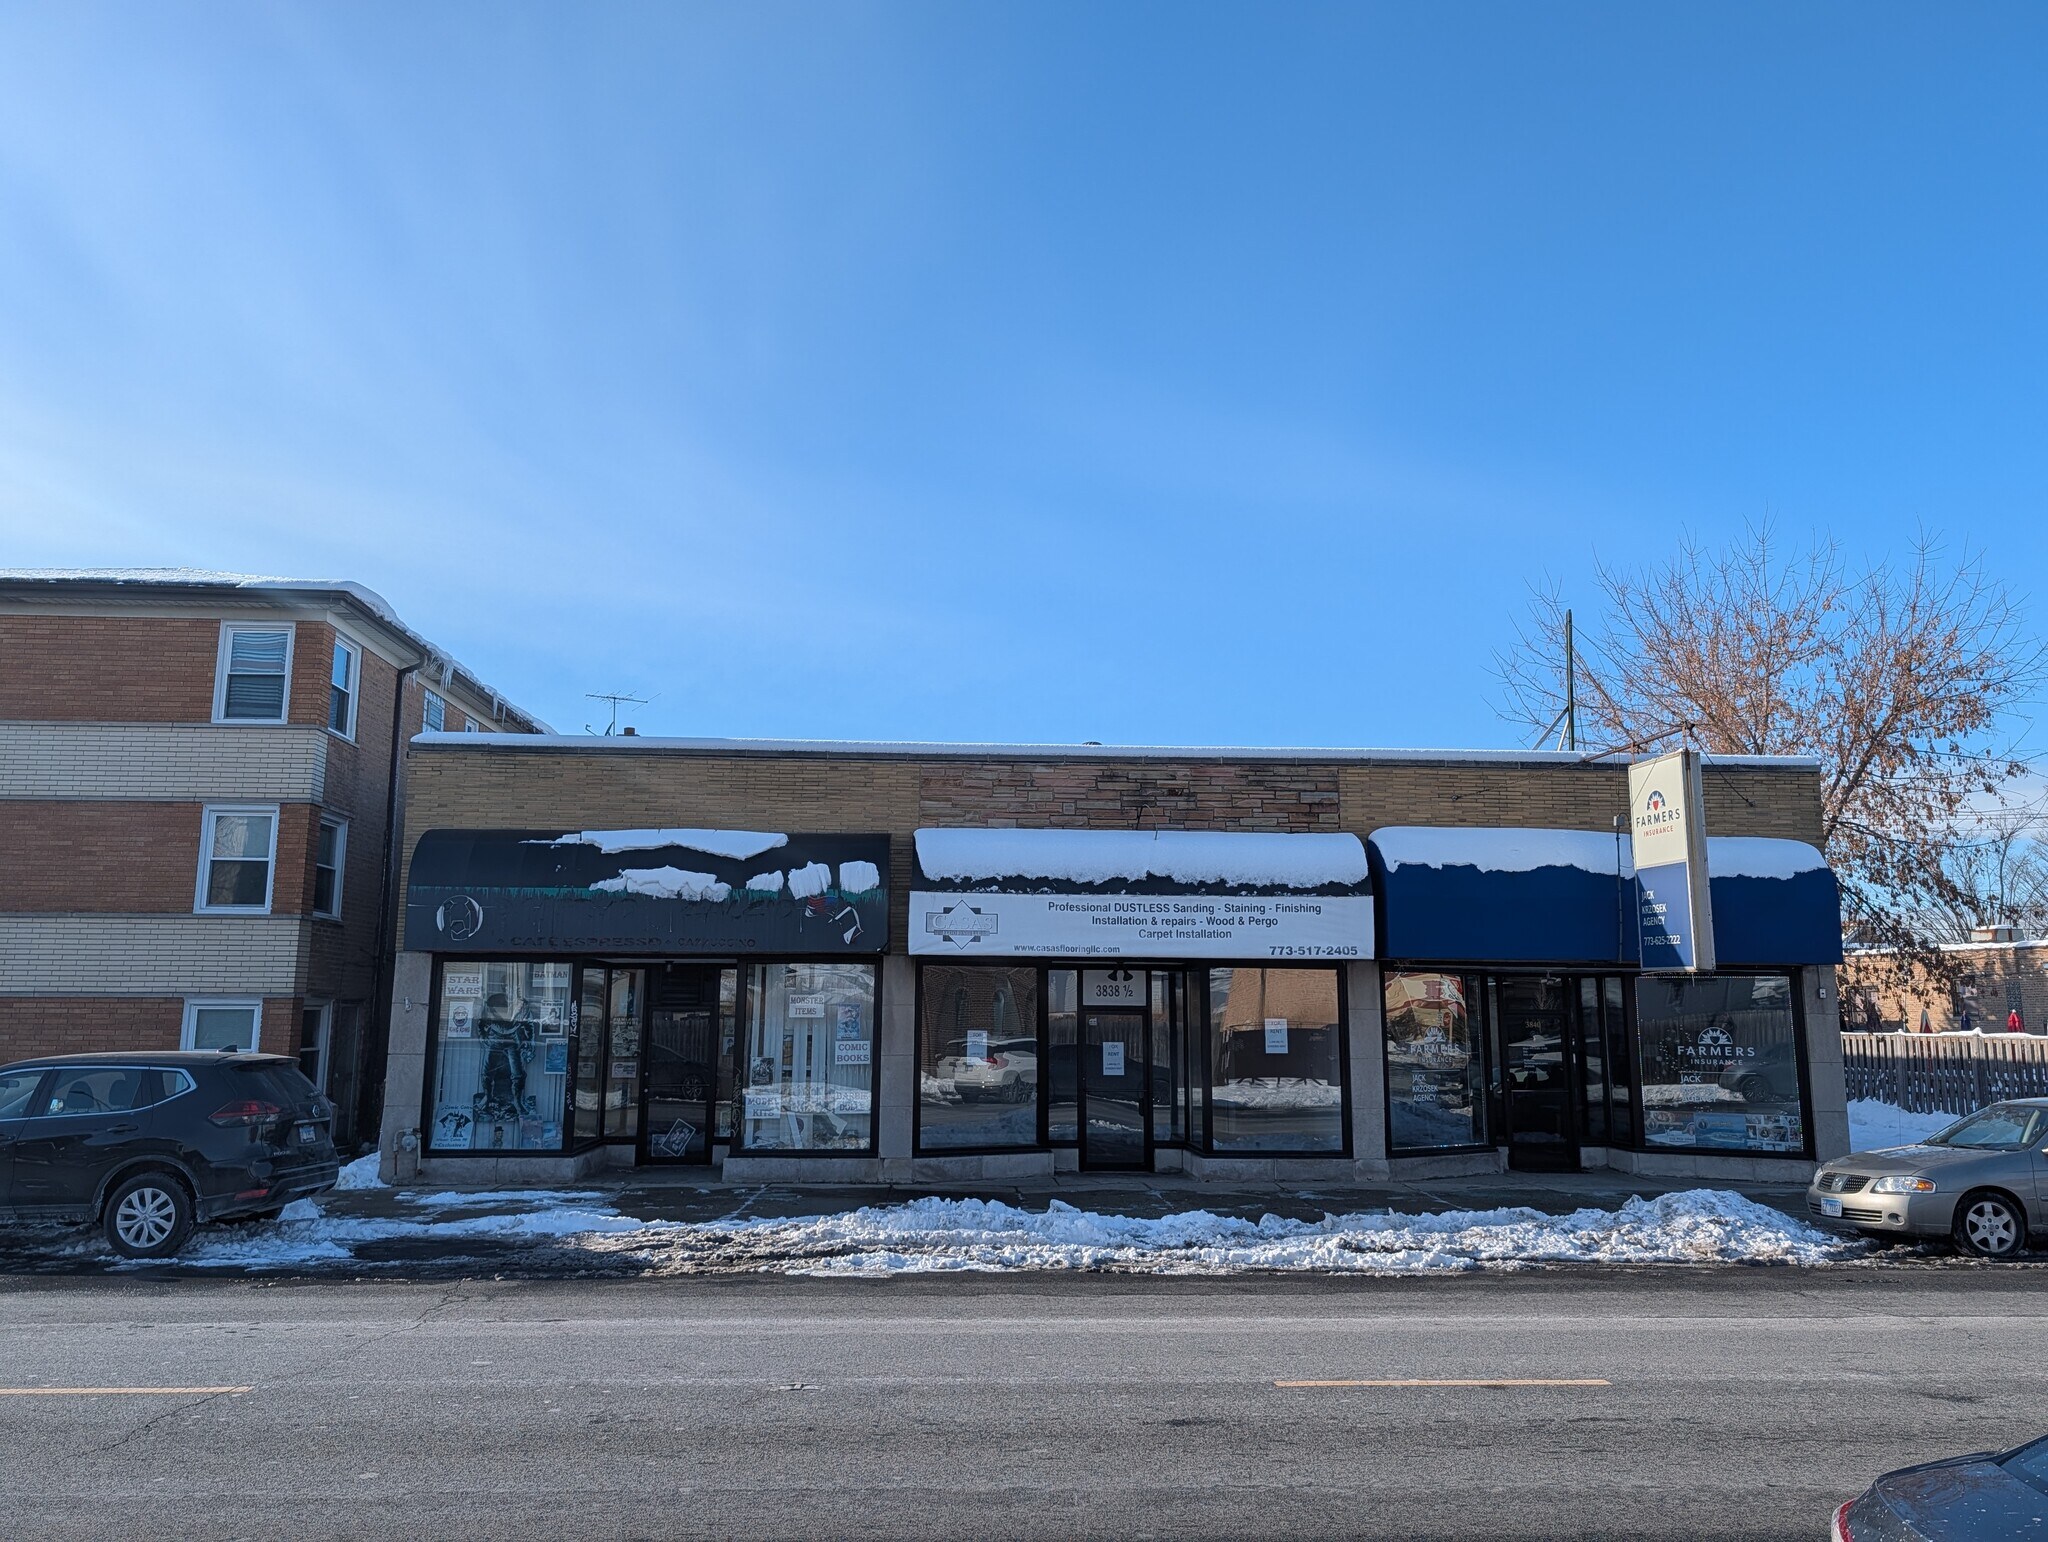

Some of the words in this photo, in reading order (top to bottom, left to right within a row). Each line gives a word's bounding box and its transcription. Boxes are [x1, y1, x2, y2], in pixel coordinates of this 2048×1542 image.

[1636, 808, 1681, 828] FARMERS
[1643, 825, 1674, 837] INSURANCE
[1641, 890, 1655, 902] JACK
[1048, 902, 1111, 912] Professional
[1114, 902, 1170, 913] DUSTLESS
[1173, 903, 1215, 915] Sanding
[1224, 903, 1266, 915] Staining
[1275, 903, 1322, 915] Finishing
[1641, 902, 1668, 914] KRZOSEK
[933, 914, 993, 930] CASAS
[1092, 915, 1148, 926] Installation
[1150, 916, 1158, 926] &
[1161, 916, 1196, 928] repairs
[1206, 916, 1235, 926] Wood
[1237, 916, 1245, 926] &
[1248, 917, 1278, 928] Pergo
[1643, 915, 1666, 927] AGENCY
[1138, 929, 1173, 940] Carpet
[1176, 929, 1232, 939] Installation
[1644, 934, 1681, 946] 773-625-2222
[1014, 944, 1120, 955] www.casasflooringllc.com
[1269, 946, 1358, 956] 773-517-2405
[534, 970, 568, 979] BATMAN
[448, 976, 480, 984] STAR
[447, 986, 481, 995] WARS
[1095, 984, 1120, 997] 3838
[791, 996, 824, 1005] MONSTER
[795, 1007, 817, 1015] ITEMS
[839, 1044, 869, 1052] COMIC
[1410, 1044, 1460, 1054] FARMERS
[1677, 1046, 1756, 1057] FARMERS
[837, 1054, 870, 1063] BOOKS
[1690, 1058, 1744, 1066] INSURANCE
[1412, 1074, 1427, 1083] JACK
[1680, 1074, 1702, 1084] JACK
[1412, 1084, 1439, 1093] KRZOSEK
[1413, 1093, 1437, 1102] AGENCY
